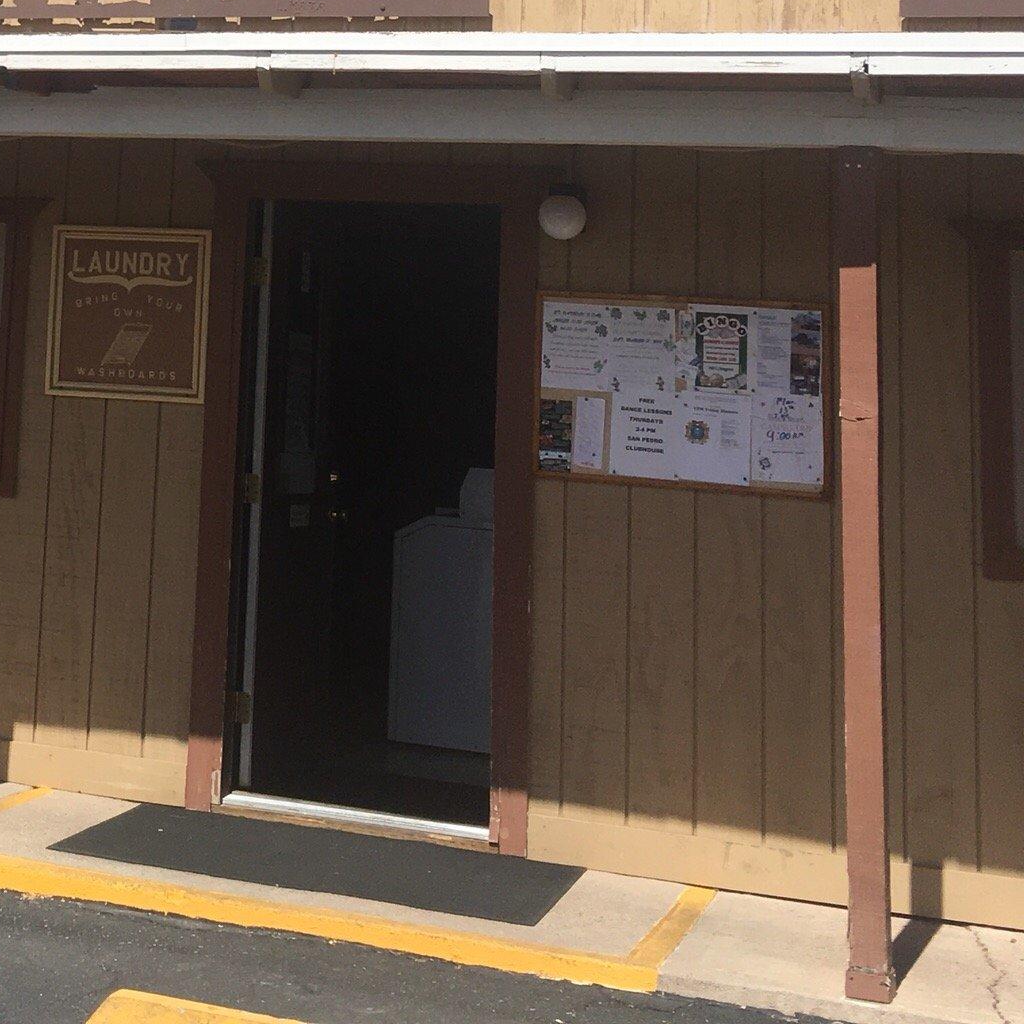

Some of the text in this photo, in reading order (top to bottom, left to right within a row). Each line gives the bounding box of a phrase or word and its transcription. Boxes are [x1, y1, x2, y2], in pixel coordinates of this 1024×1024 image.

[72, 249, 189, 277] LAUNDRY
[75, 291, 183, 313] BRING YOUR
[113, 307, 143, 318] OWN
[697, 316, 747, 336] BINGO
[77, 366, 176, 381] WASHBOARDS
[643, 408, 673, 416] LESSONS
